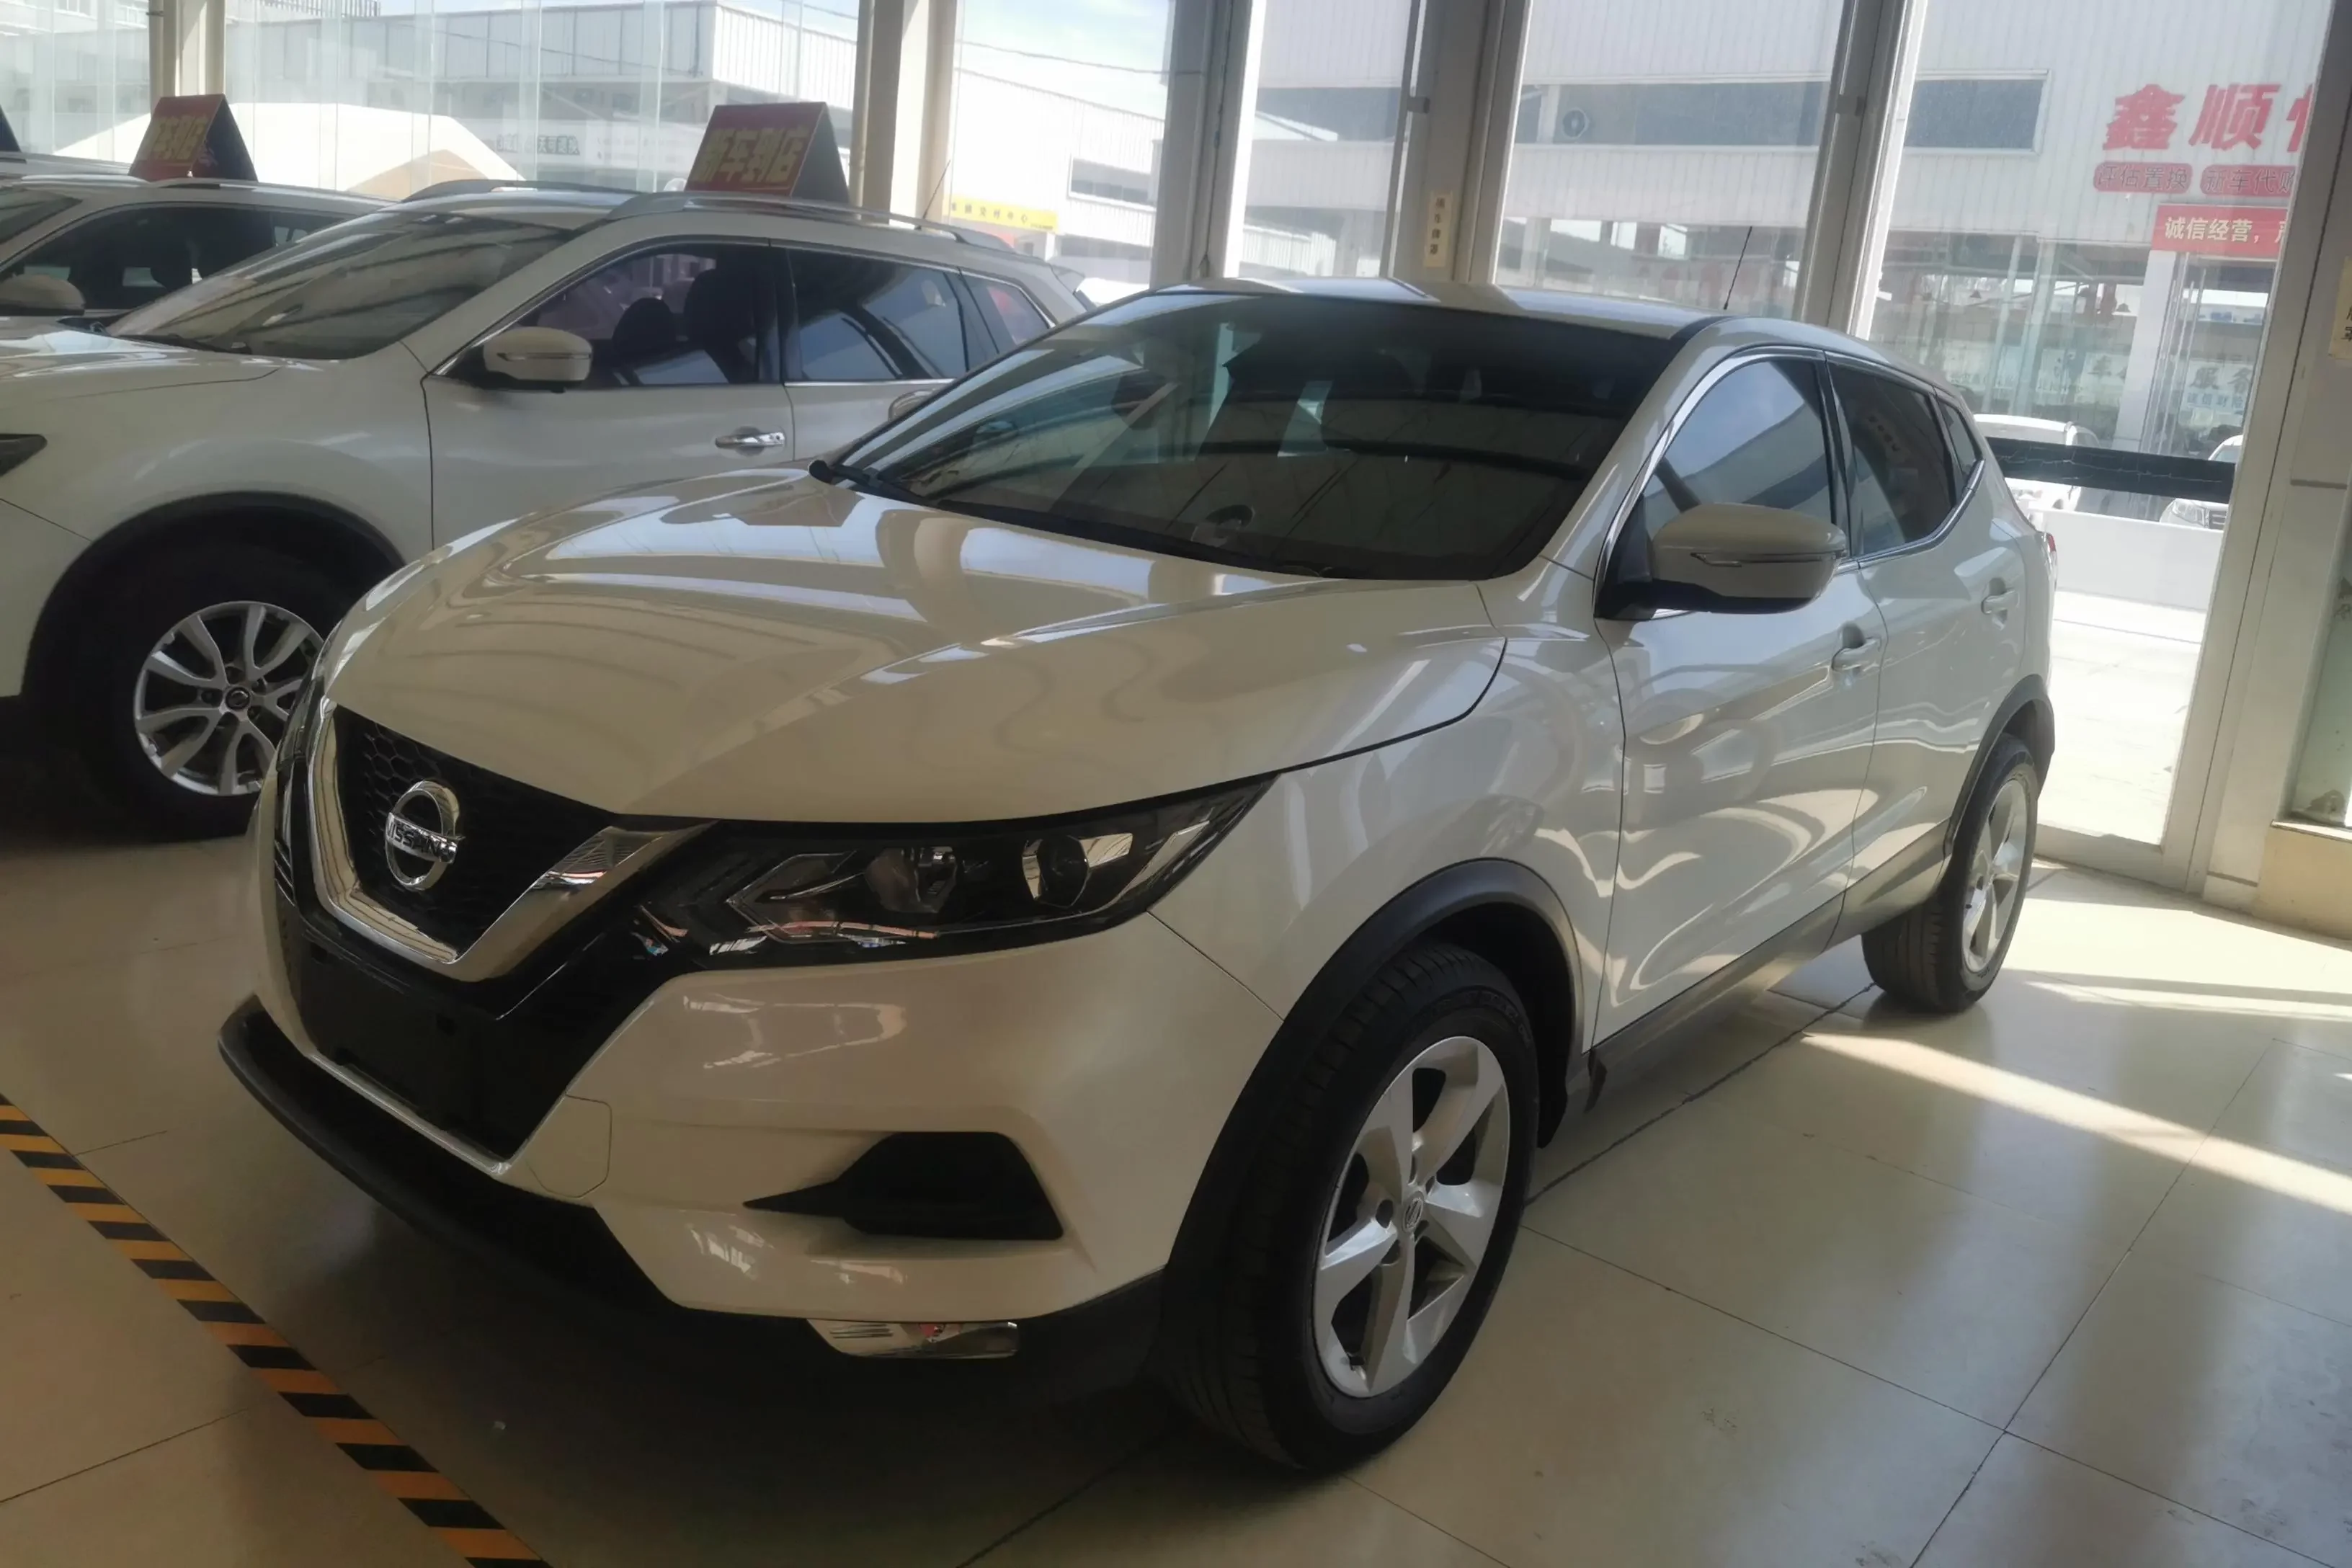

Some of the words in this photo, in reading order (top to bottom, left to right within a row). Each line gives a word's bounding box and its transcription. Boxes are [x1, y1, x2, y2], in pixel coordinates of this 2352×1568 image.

[694, 126, 811, 182] 新车到店
[2096, 164, 2188, 190] 评估置换
